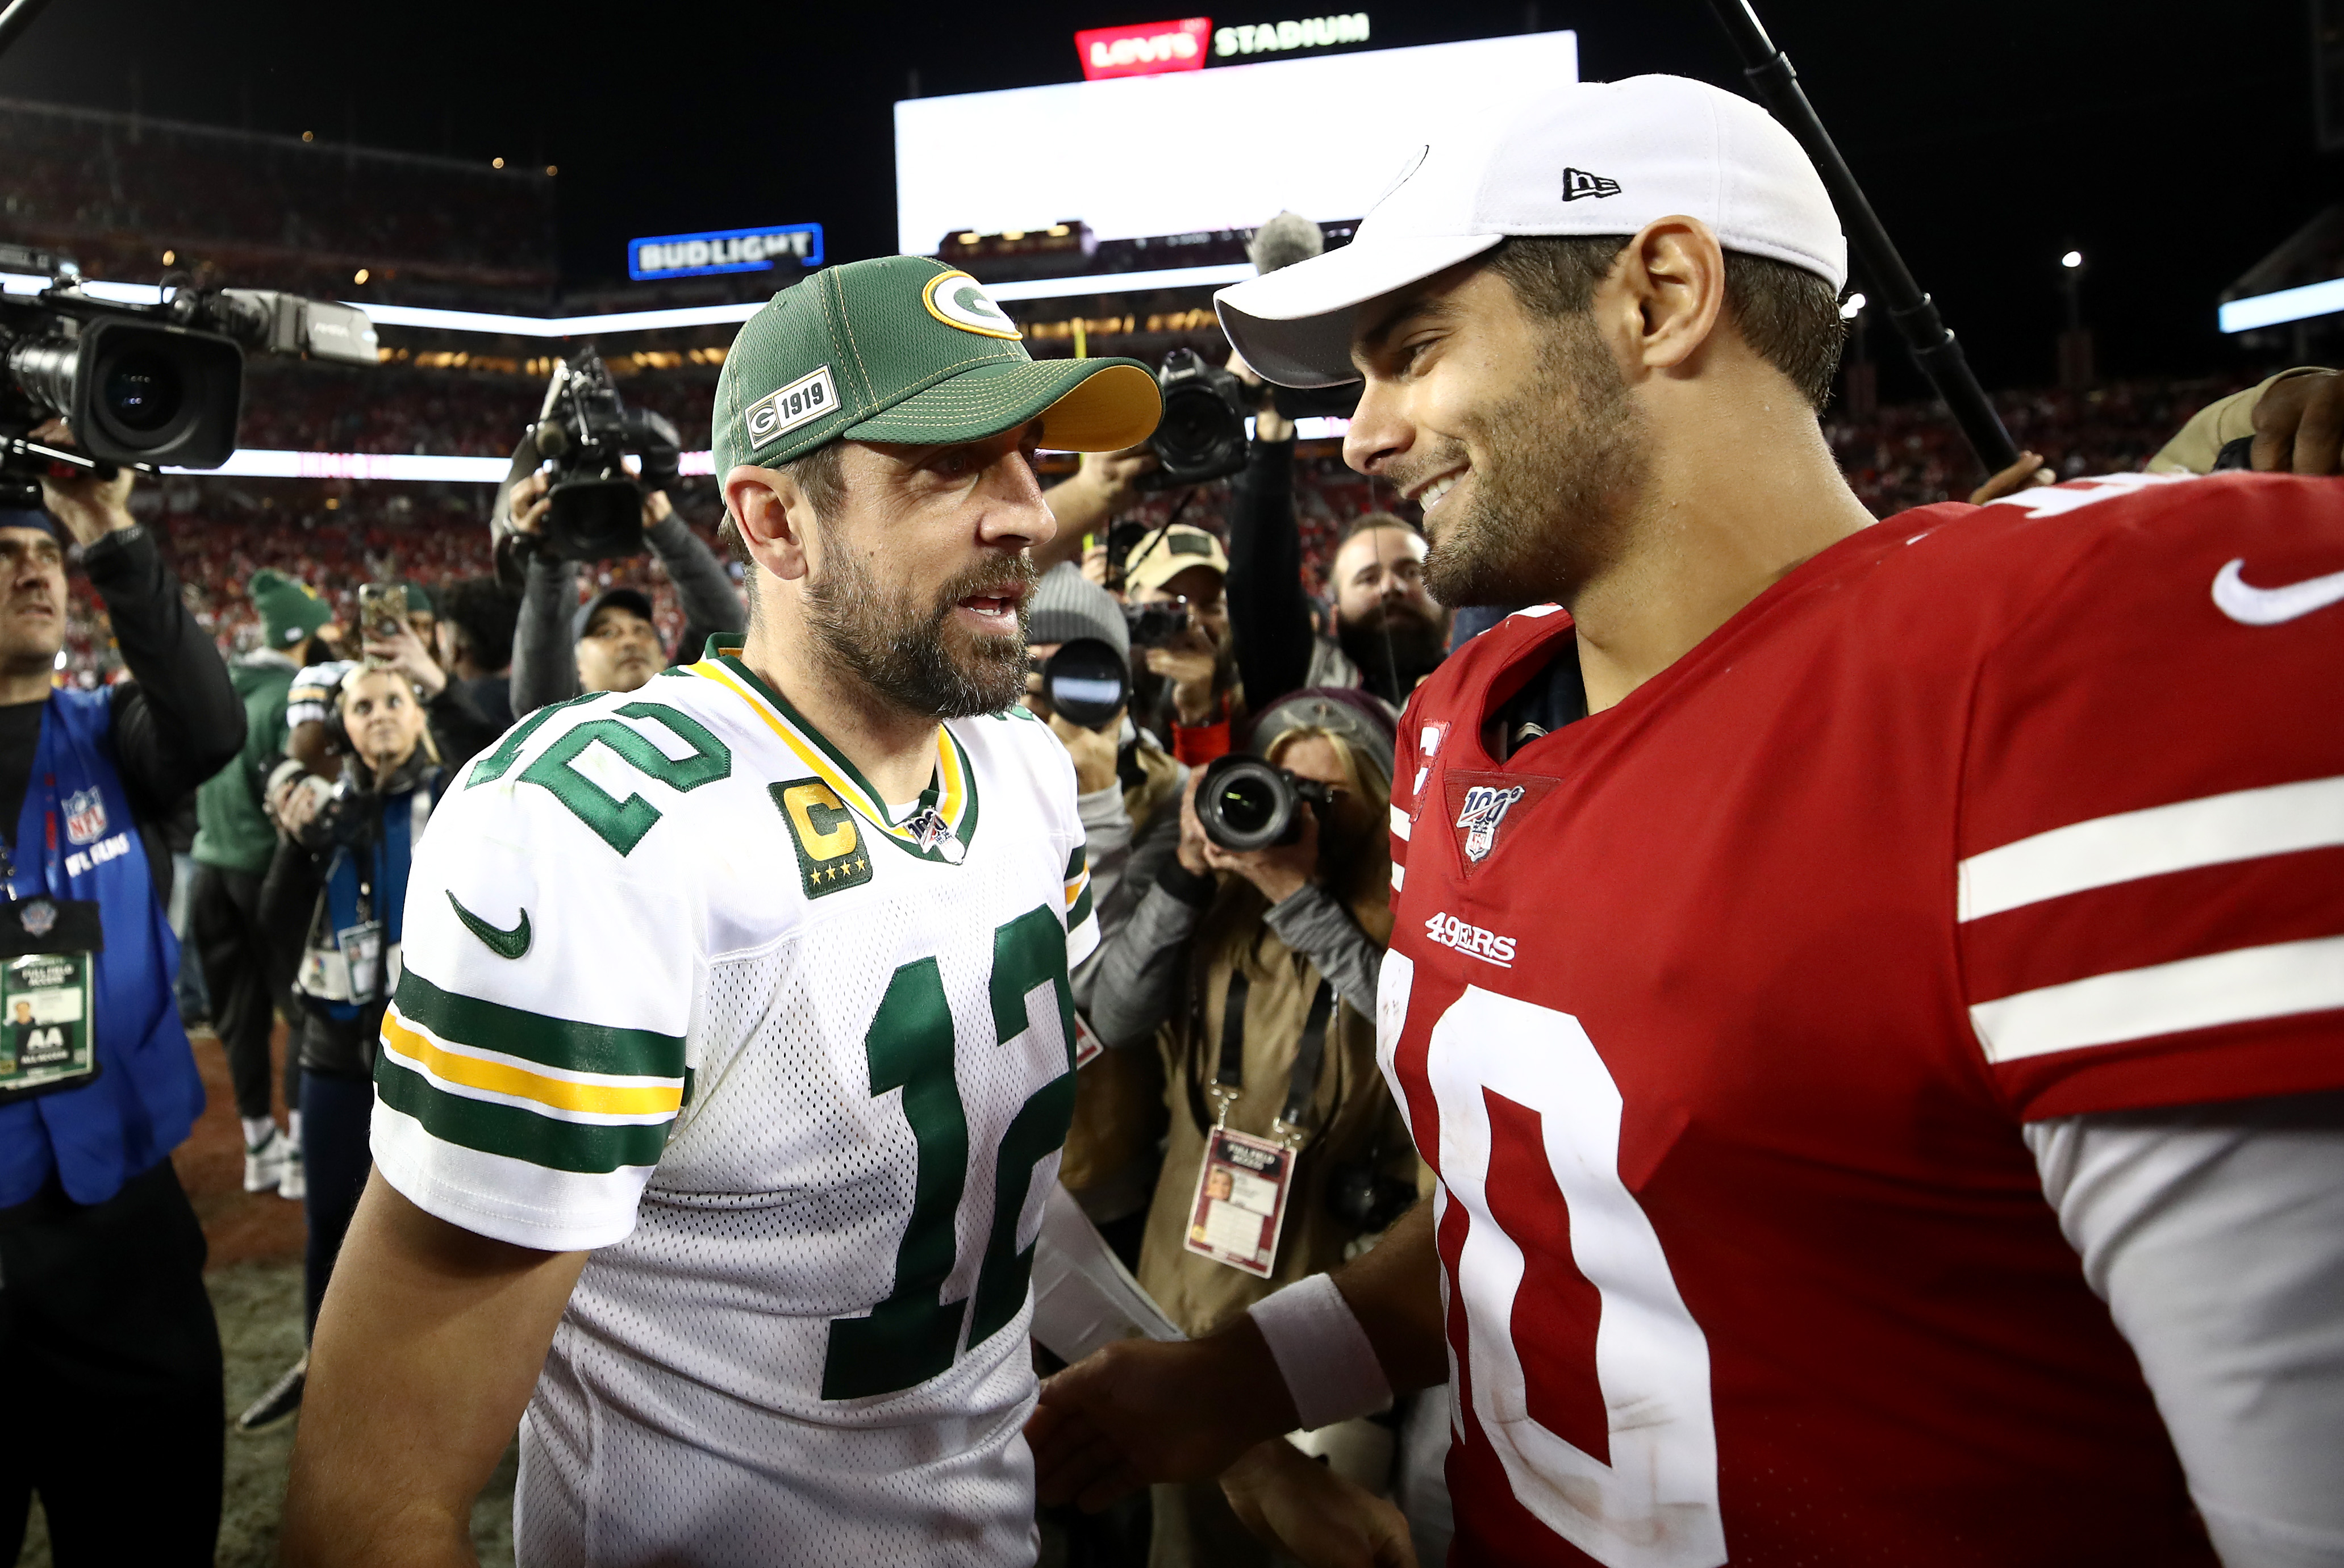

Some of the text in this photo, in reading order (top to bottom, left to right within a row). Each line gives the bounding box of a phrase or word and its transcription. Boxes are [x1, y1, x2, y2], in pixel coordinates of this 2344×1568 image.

[1215, 12, 1370, 57] STADIUM
[782, 382, 824, 419] 1919
[464, 690, 732, 858] 12
[66, 807, 105, 839] NFL
[783, 783, 857, 861] C
[1425, 911, 1517, 964] 49ERS
[27, 1027, 64, 1050] AA
[821, 903, 1077, 1401] 12
